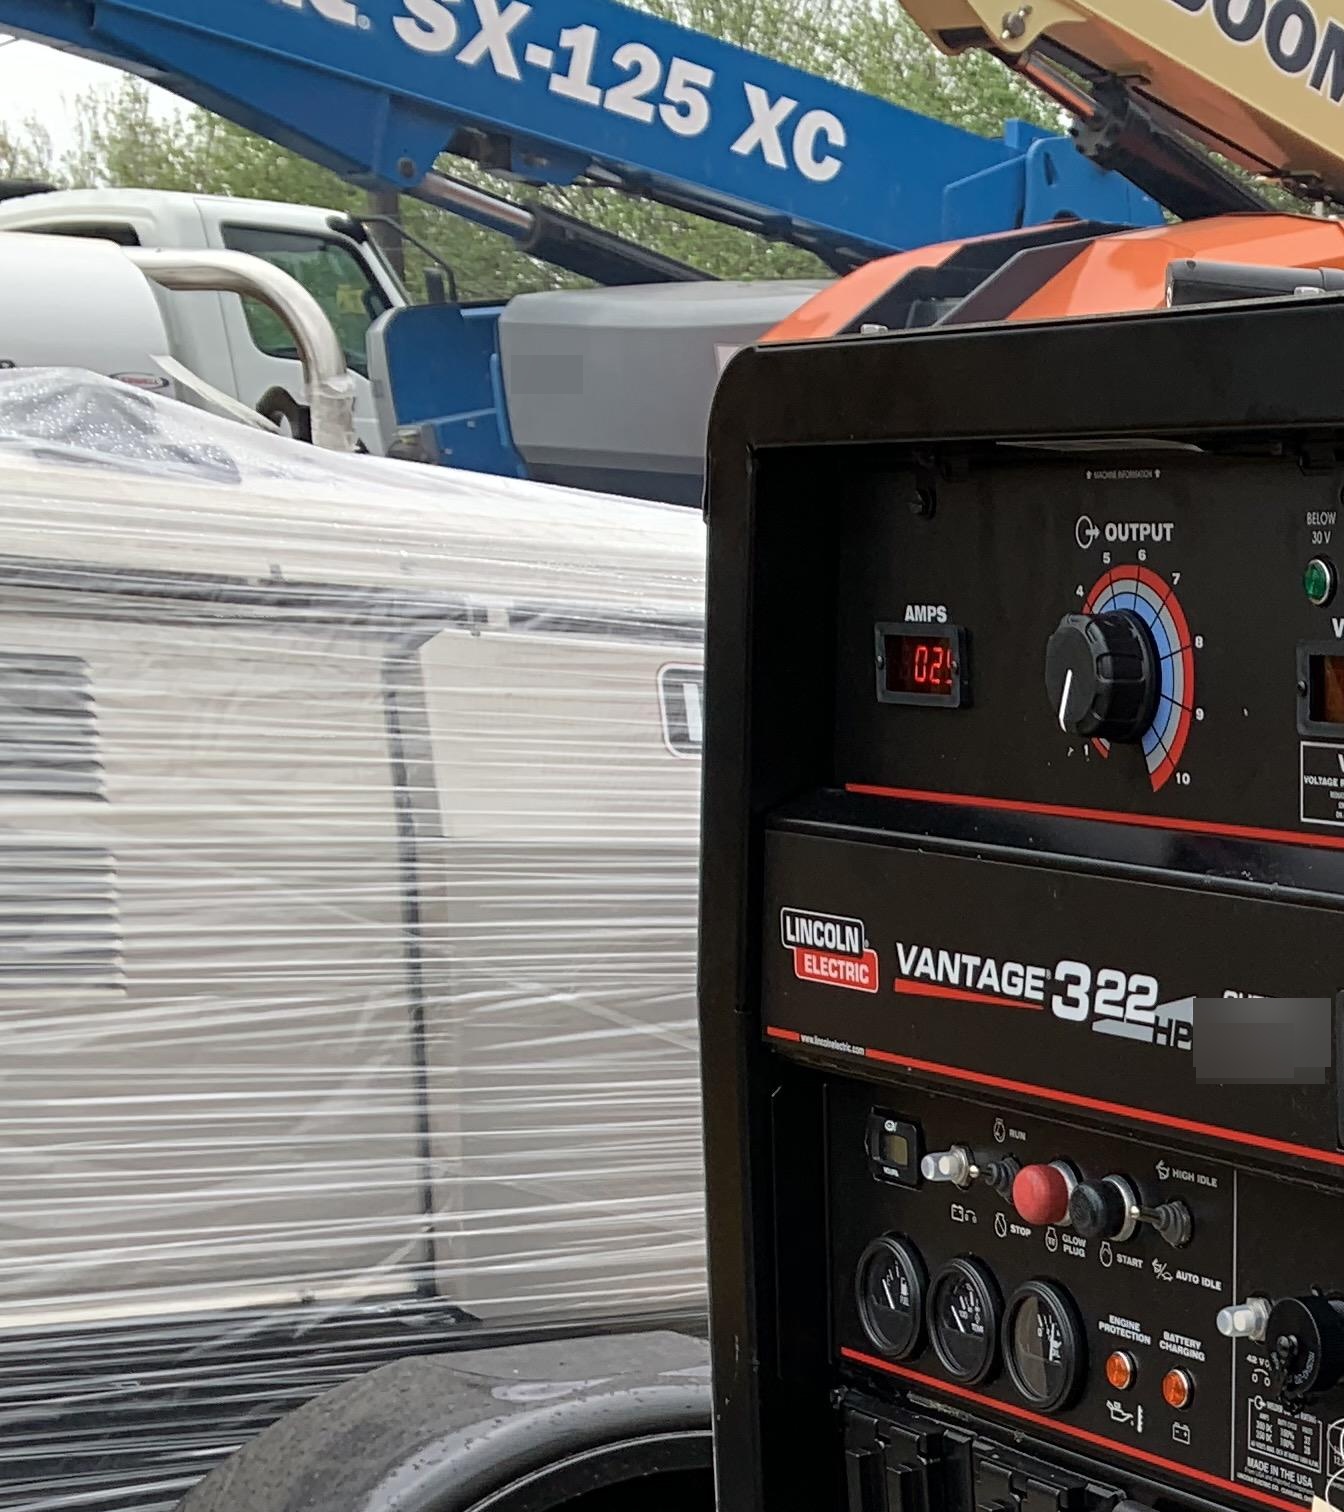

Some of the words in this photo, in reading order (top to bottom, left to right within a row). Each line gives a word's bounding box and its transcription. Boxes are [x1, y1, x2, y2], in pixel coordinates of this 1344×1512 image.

[730, 82, 847, 181] XC
[1306, 512, 1336, 525] BELOW
[1105, 522, 1174, 541] OUTPUT
[1312, 531, 1323, 544] 30
[1102, 551, 1111, 564] 5
[1138, 549, 1147, 561] 6
[1171, 572, 1181, 584] 7
[1075, 585, 1084, 597] 4
[904, 604, 948, 623] AMPS
[1195, 636, 1204, 649] 8
[1195, 708, 1205, 721] 9
[1175, 772, 1191, 785] 10
[1303, 775, 1339, 787] VOLTAGE
[785, 915, 860, 954] LINCOLN
[803, 954, 870, 984] ELECTRIC
[1052, 960, 1159, 1023] 322
[1009, 1128, 1027, 1141] RUN
[1171, 1167, 1195, 1182] HIGH
[1196, 1173, 1218, 1188] IDLE
[1010, 1224, 1031, 1237] STOP
[1062, 1233, 1087, 1248] GLOW
[1063, 1243, 1086, 1258] PLUG
[1116, 1253, 1144, 1268] START
[1175, 1270, 1200, 1285] AUTO
[1201, 1276, 1223, 1291] IDLE
[1108, 1314, 1141, 1332] ENGINE
[1098, 1321, 1151, 1345] PROTECTION
[1163, 1331, 1202, 1350] BATTERY
[1159, 1339, 1206, 1362] CHARGING
[1247, 1456, 1269, 1472] MADE
[1270, 1464, 1278, 1477] IN
[1280, 1467, 1296, 1482] THE
[1296, 1472, 1313, 1488] USA
